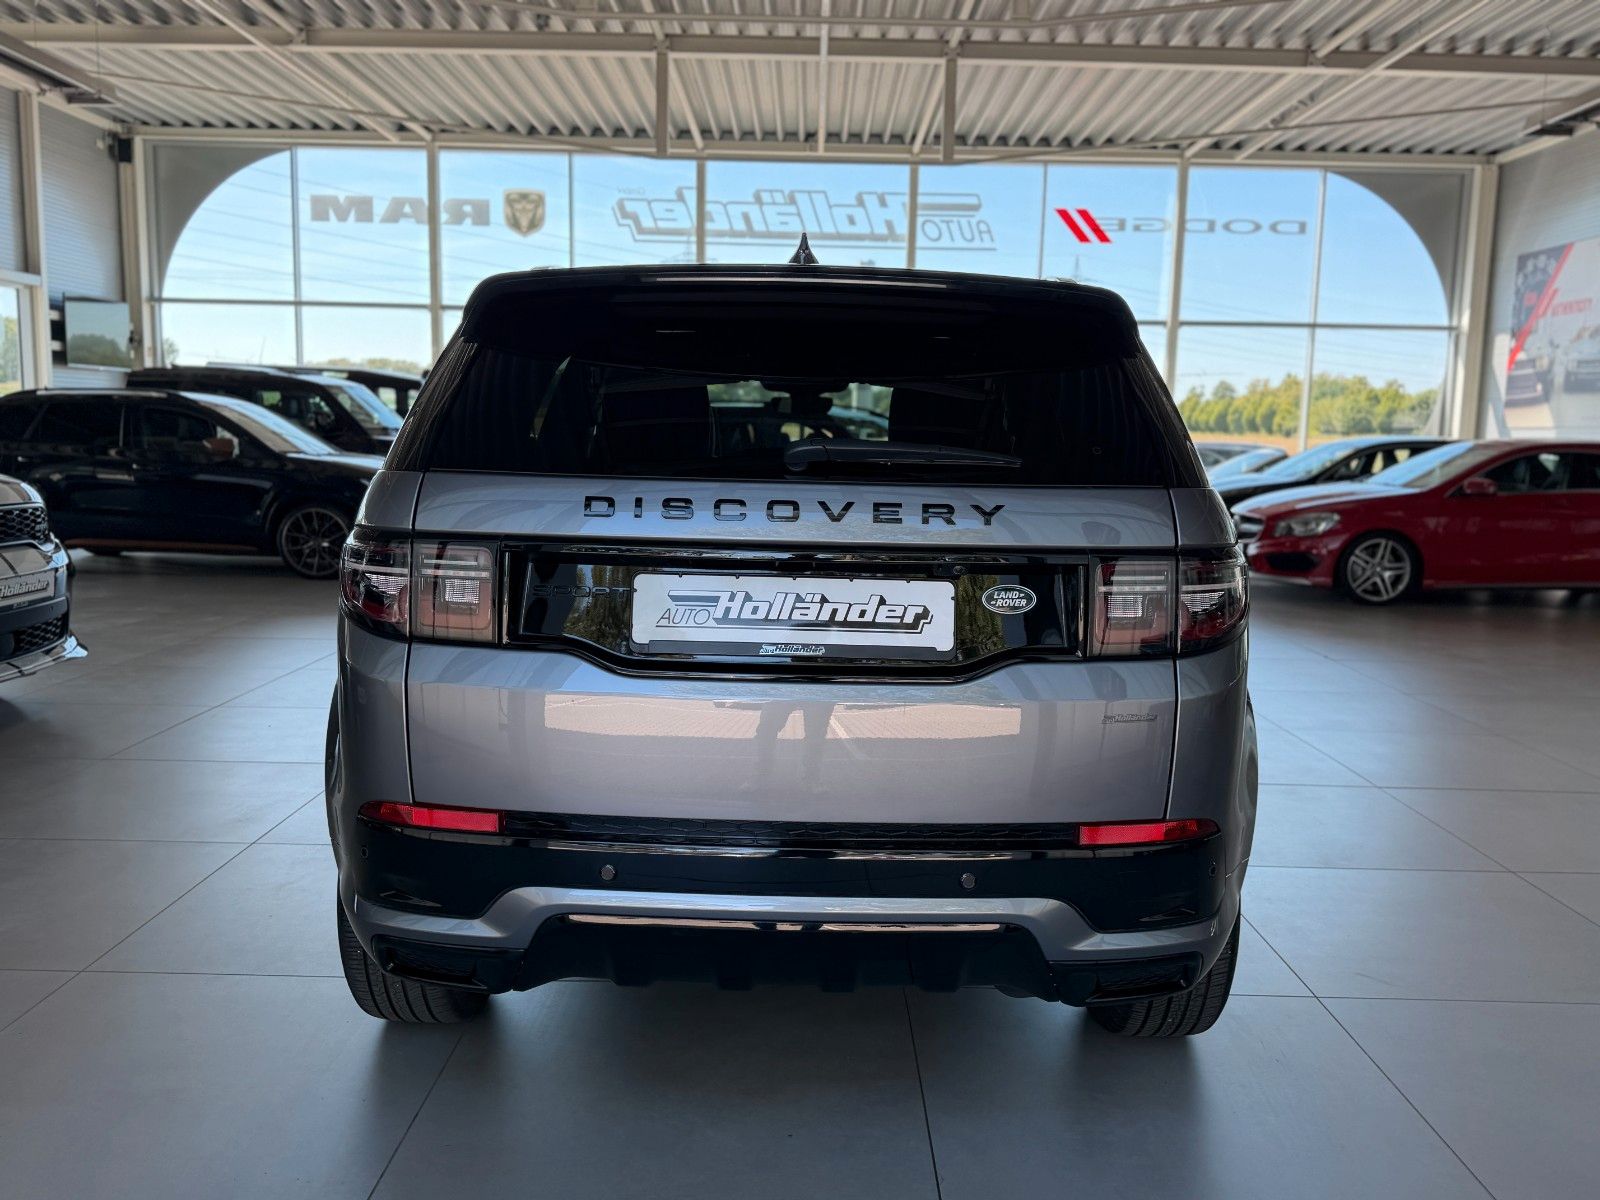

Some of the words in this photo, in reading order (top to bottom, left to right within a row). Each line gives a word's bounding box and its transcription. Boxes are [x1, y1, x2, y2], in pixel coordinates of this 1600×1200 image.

[584, 494, 1006, 526] DISCOVERY
[533, 585, 632, 598] SPORT
[993, 590, 1019, 599] LAND
[995, 599, 1027, 607] ROVER
[656, 608, 712, 625] AUTO
[711, 591, 933, 632] Holländer
